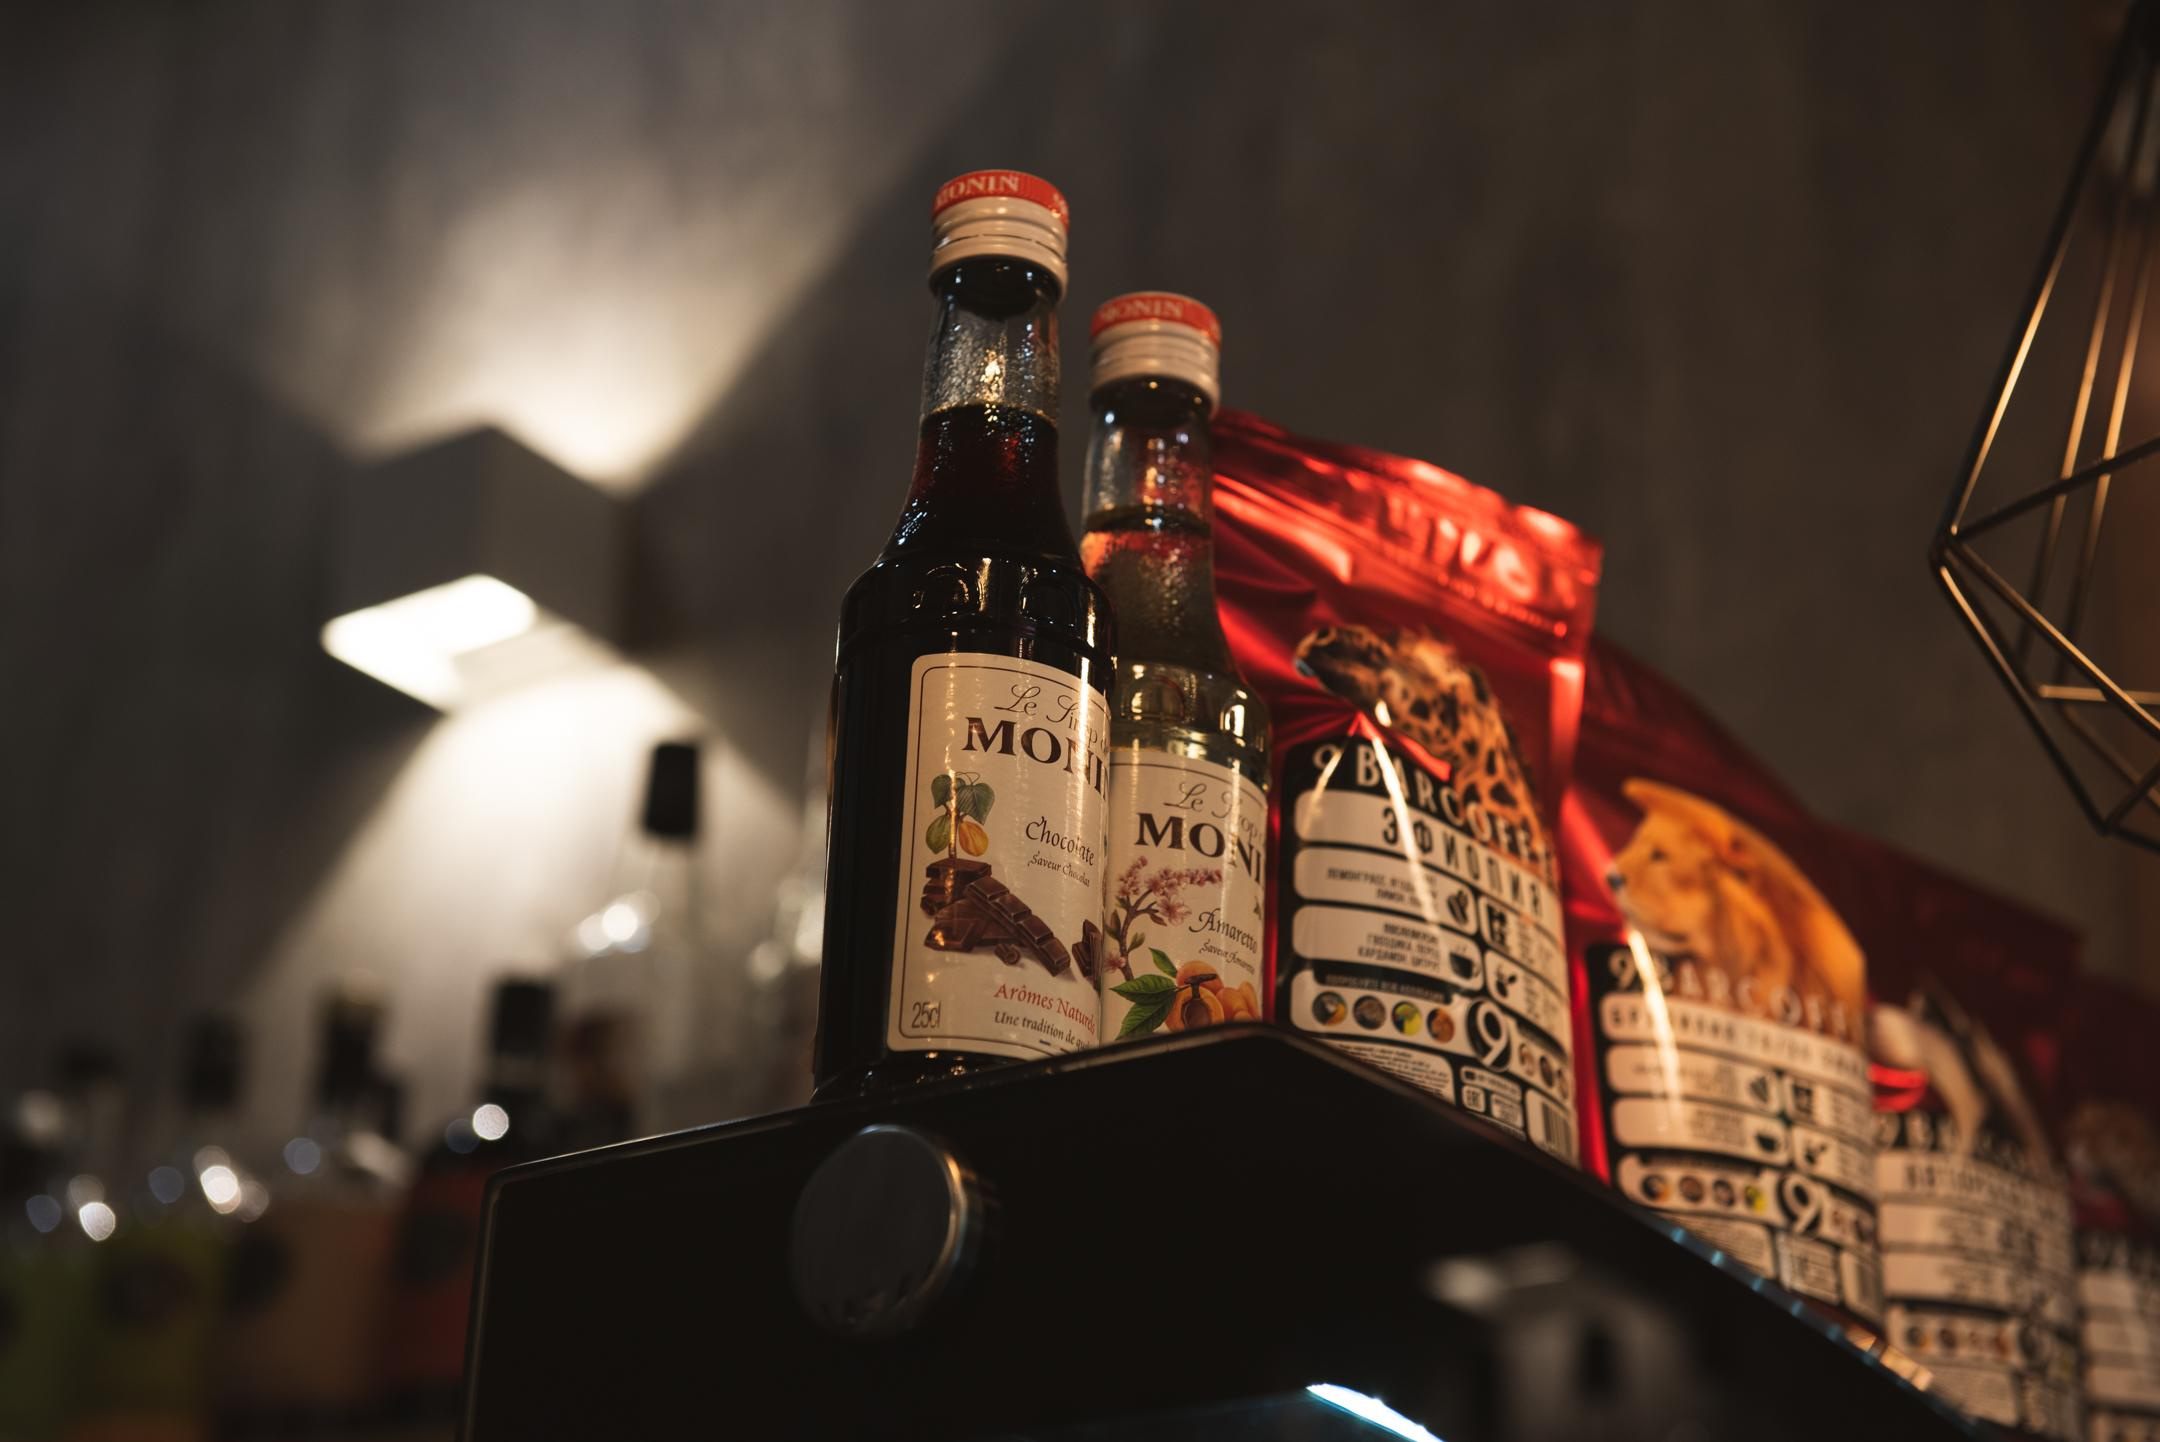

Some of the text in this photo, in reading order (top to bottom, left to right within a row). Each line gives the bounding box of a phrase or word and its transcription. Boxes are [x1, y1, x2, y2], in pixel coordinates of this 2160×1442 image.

[994, 684, 1041, 716] Le
[1046, 694, 1098, 748] Sirp
[1163, 782, 1207, 812] Le
[1025, 816, 1095, 866] Chocolate
[1027, 850, 1090, 888] Saveur Chocolat
[1188, 908, 1257, 954] Amaretto
[911, 1001, 942, 1030] 25cl
[993, 983, 1095, 1036] Arômes Naturels
[994, 1011, 1019, 1027] Une
[1021, 1018, 1064, 1041] tradition
[1065, 1029, 1076, 1045] de
